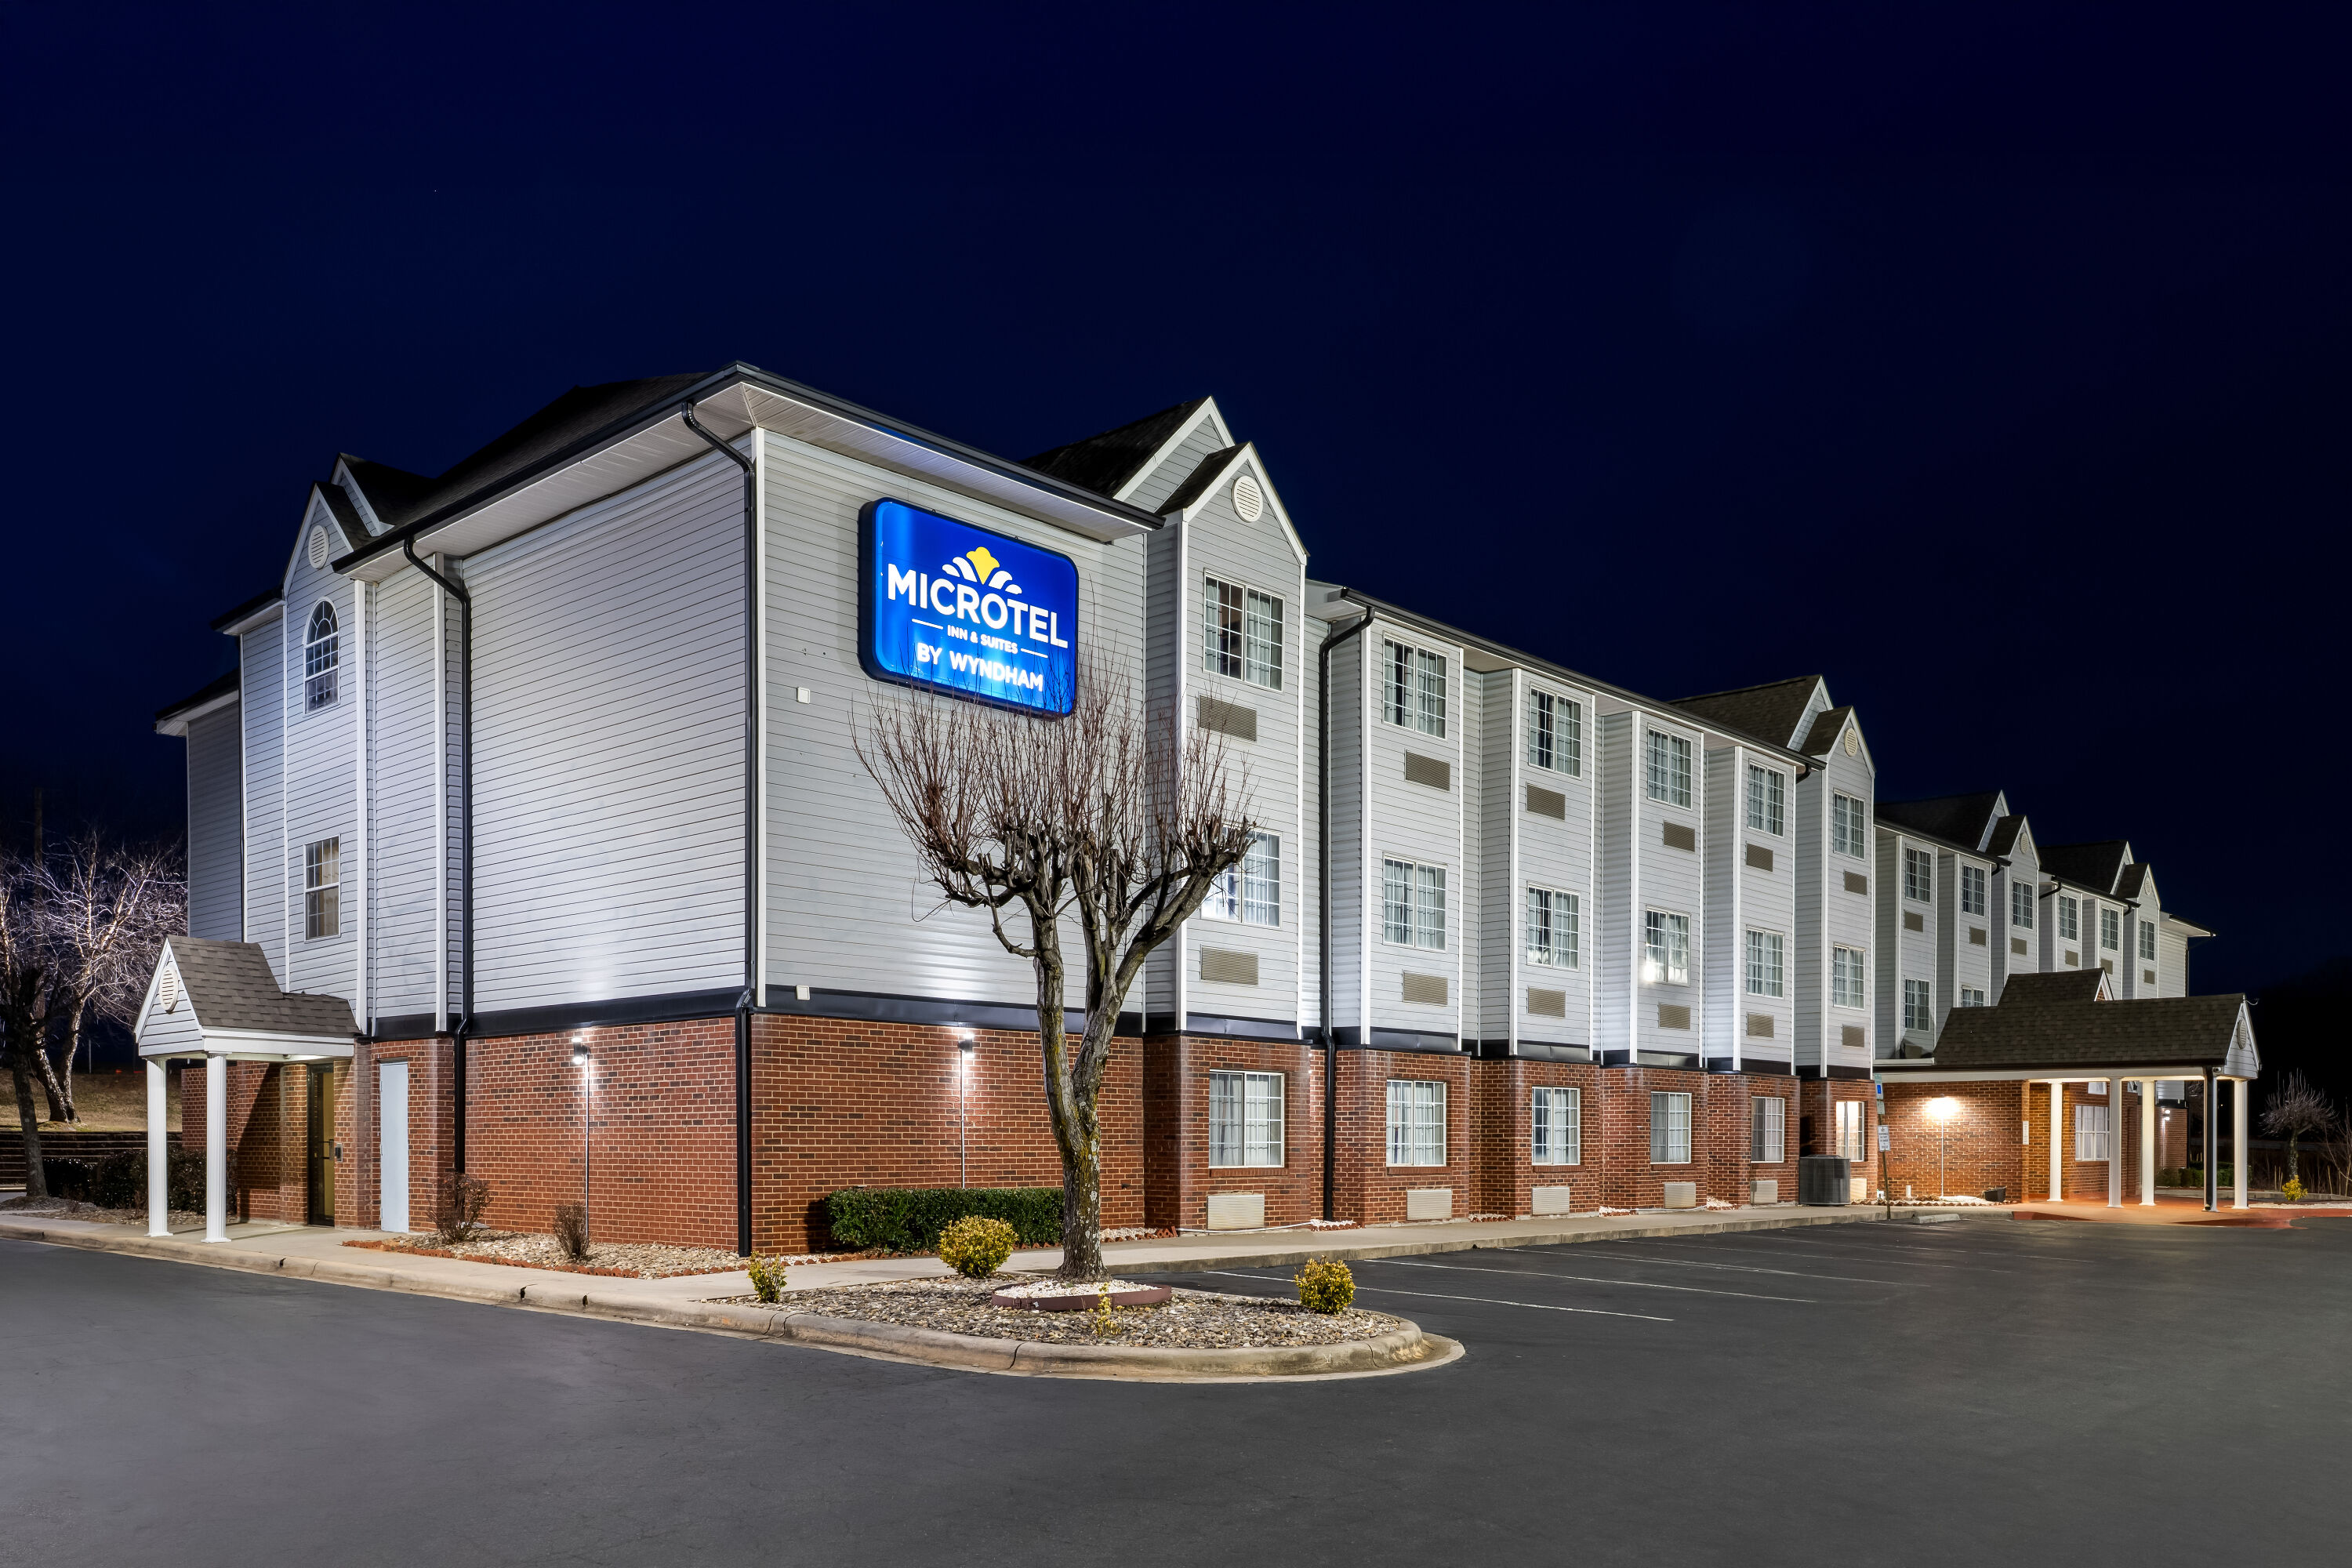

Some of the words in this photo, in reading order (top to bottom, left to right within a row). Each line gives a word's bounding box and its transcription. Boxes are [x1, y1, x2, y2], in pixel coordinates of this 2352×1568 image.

[887, 563, 1069, 649] MICROTEL
[947, 625, 968, 641] INN
[970, 631, 978, 644] &
[980, 633, 1018, 655] SUITES
[917, 642, 942, 665] BY
[949, 650, 1044, 691] WYNDHAM
